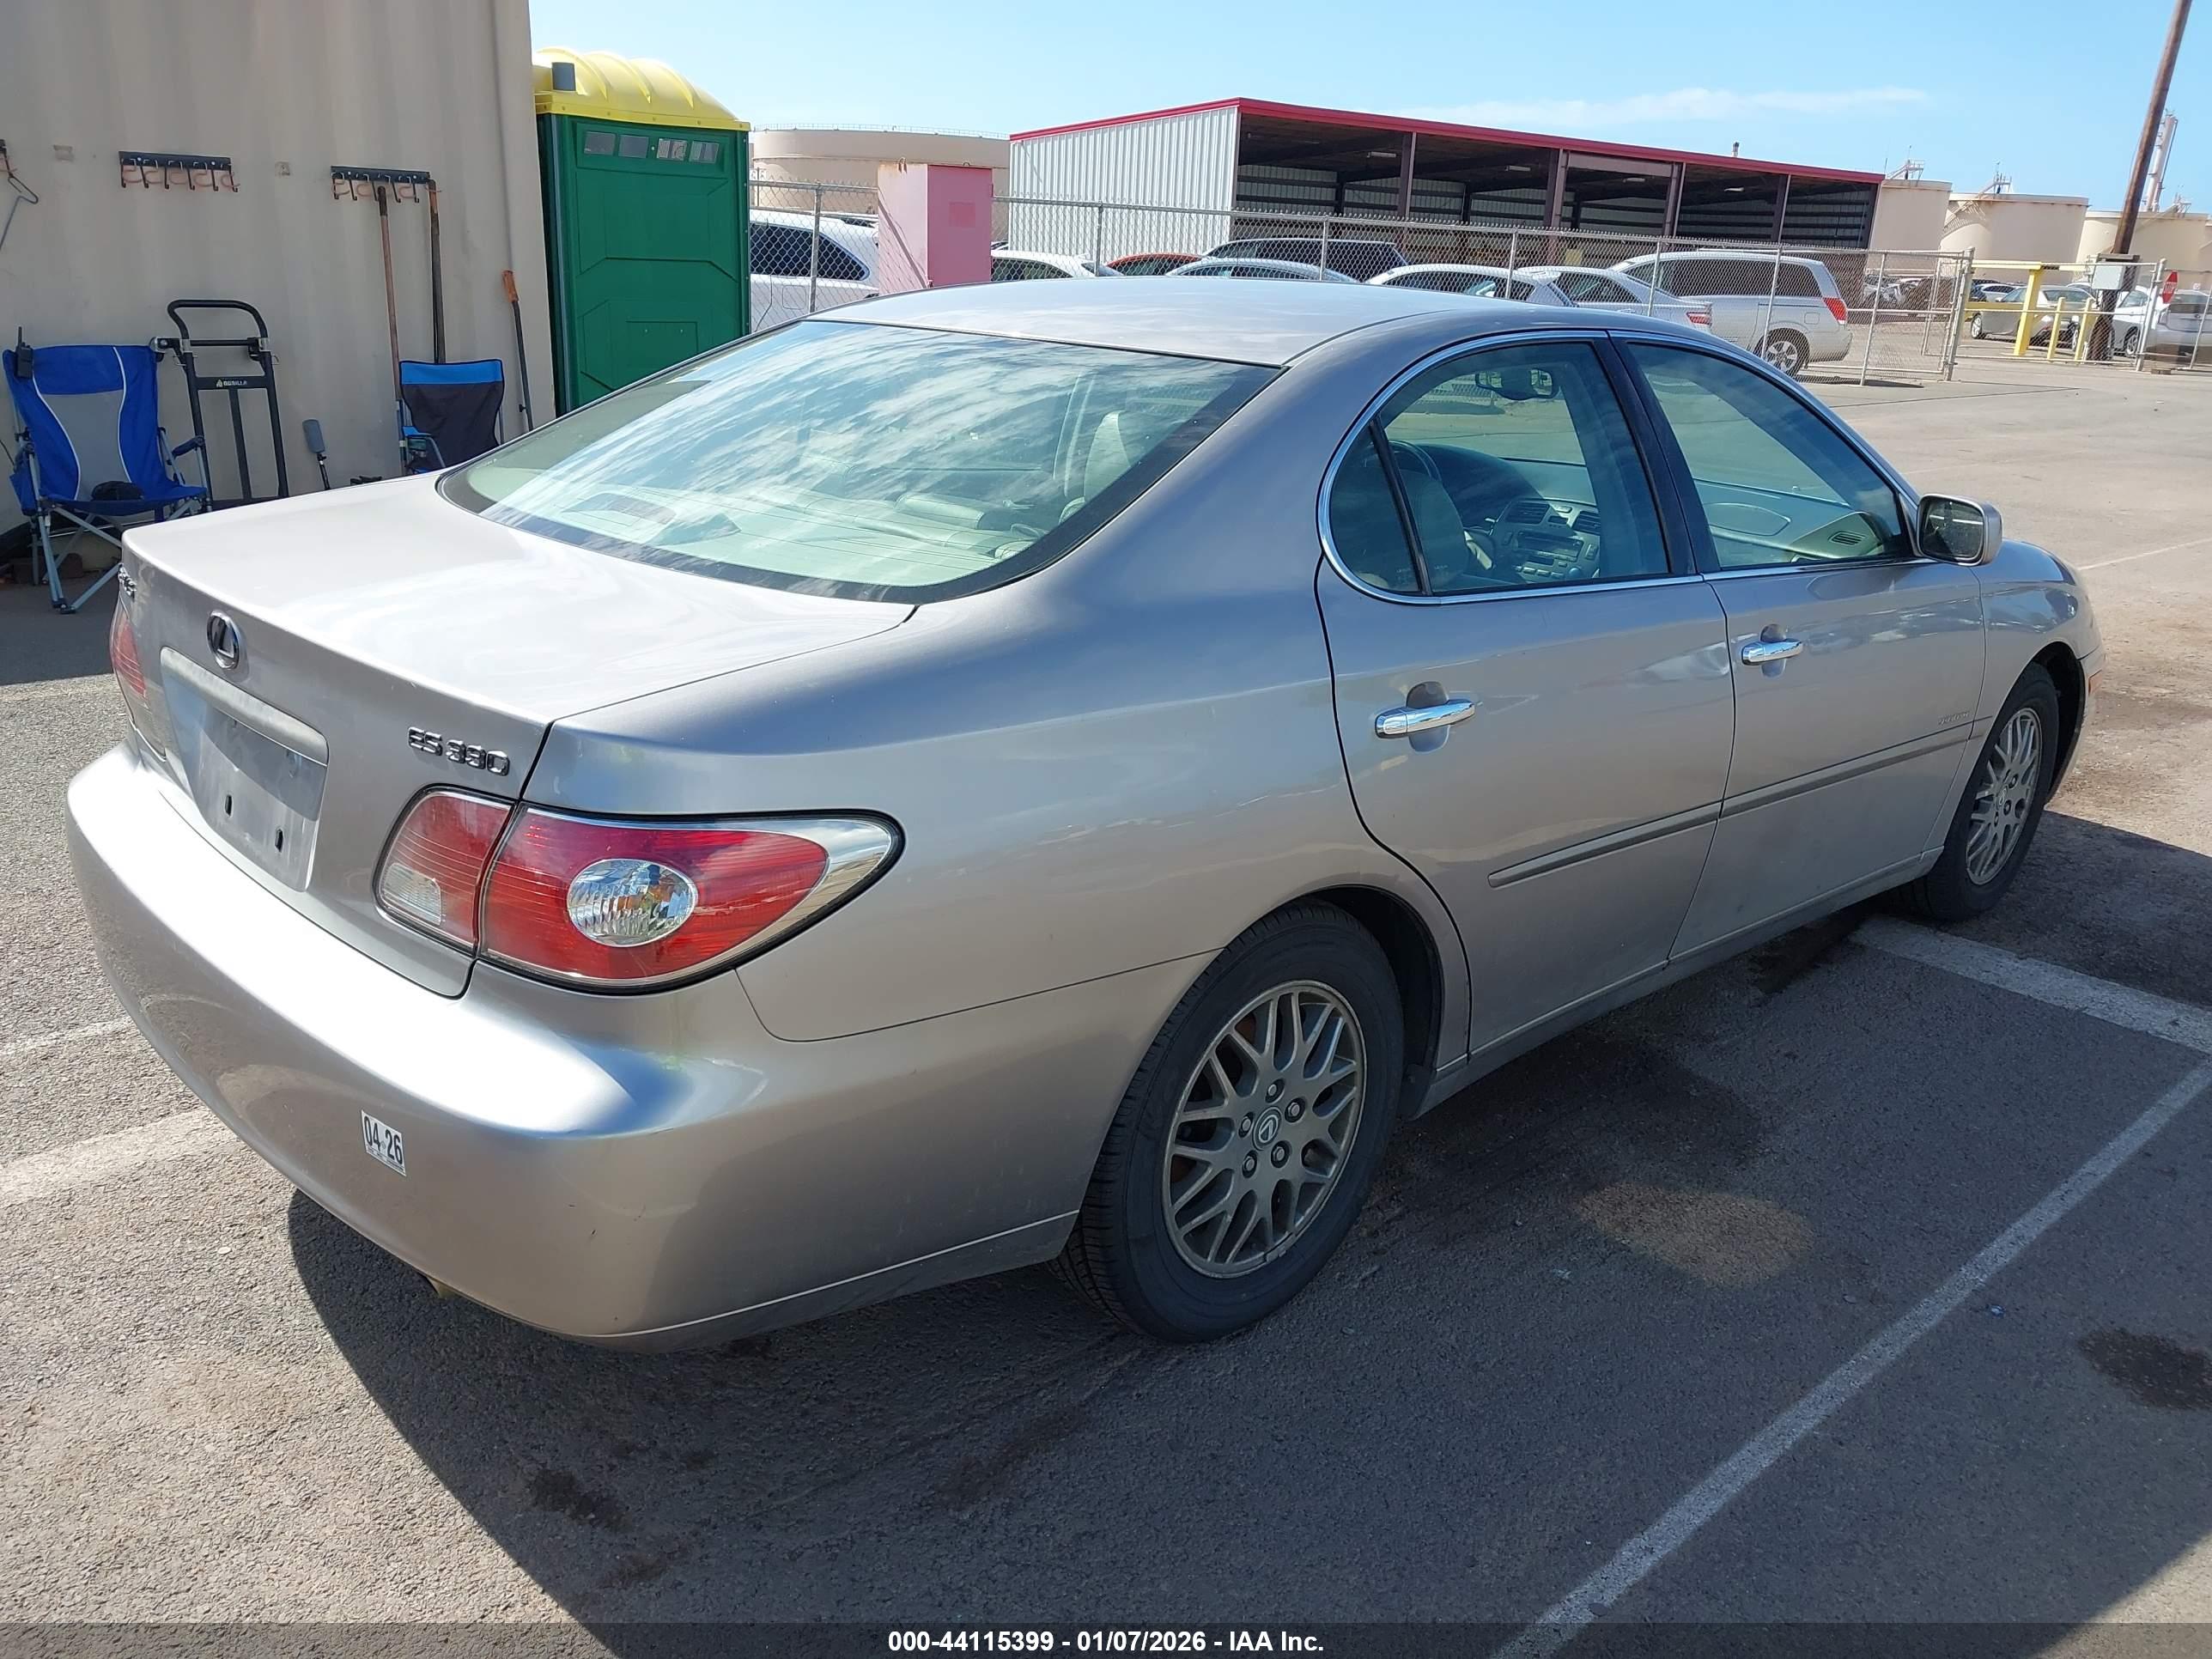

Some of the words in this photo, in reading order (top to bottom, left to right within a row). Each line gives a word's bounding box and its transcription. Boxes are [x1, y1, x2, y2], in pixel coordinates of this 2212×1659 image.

[2163, 282, 2178, 294] STOP
[408, 726, 443, 757] ES
[446, 739, 510, 777] 330
